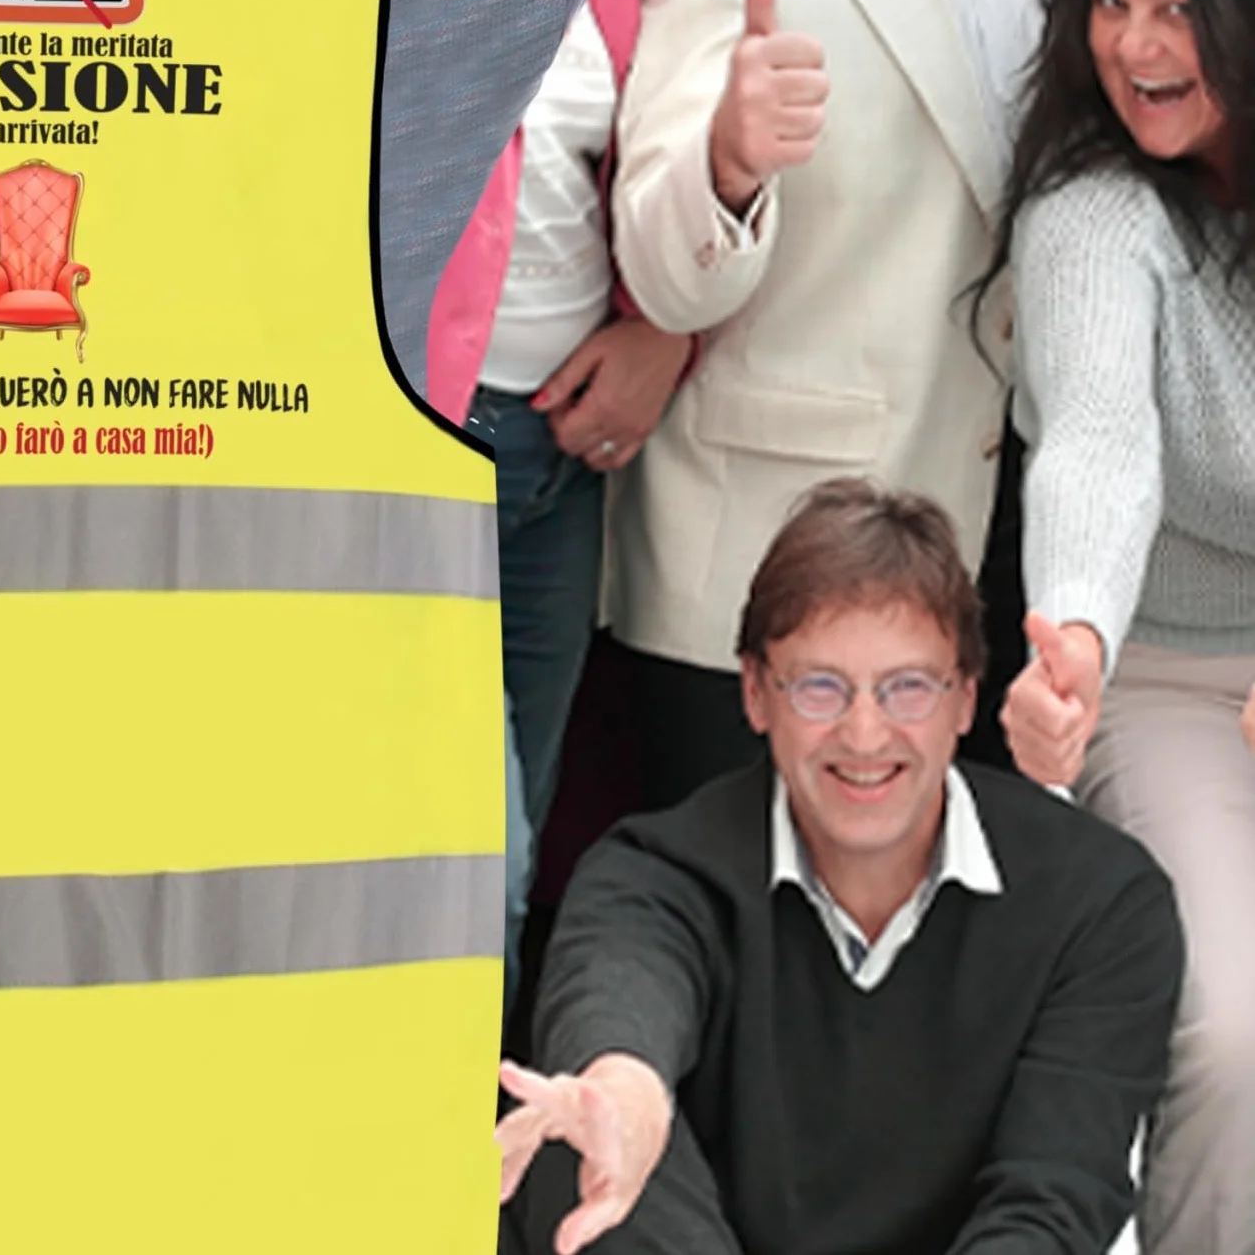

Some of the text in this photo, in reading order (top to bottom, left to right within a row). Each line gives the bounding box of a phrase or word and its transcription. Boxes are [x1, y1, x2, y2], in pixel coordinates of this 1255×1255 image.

[41, 32, 63, 56] la
[72, 34, 173, 58] meritata
[77, 377, 94, 409] A
[105, 377, 160, 409] NON
[169, 379, 229, 410] FARE
[238, 380, 309, 413] NULLA
[16, 421, 65, 455] farò
[73, 427, 87, 455] a
[96, 427, 146, 455] casa
[154, 424, 214, 459] mia!)
